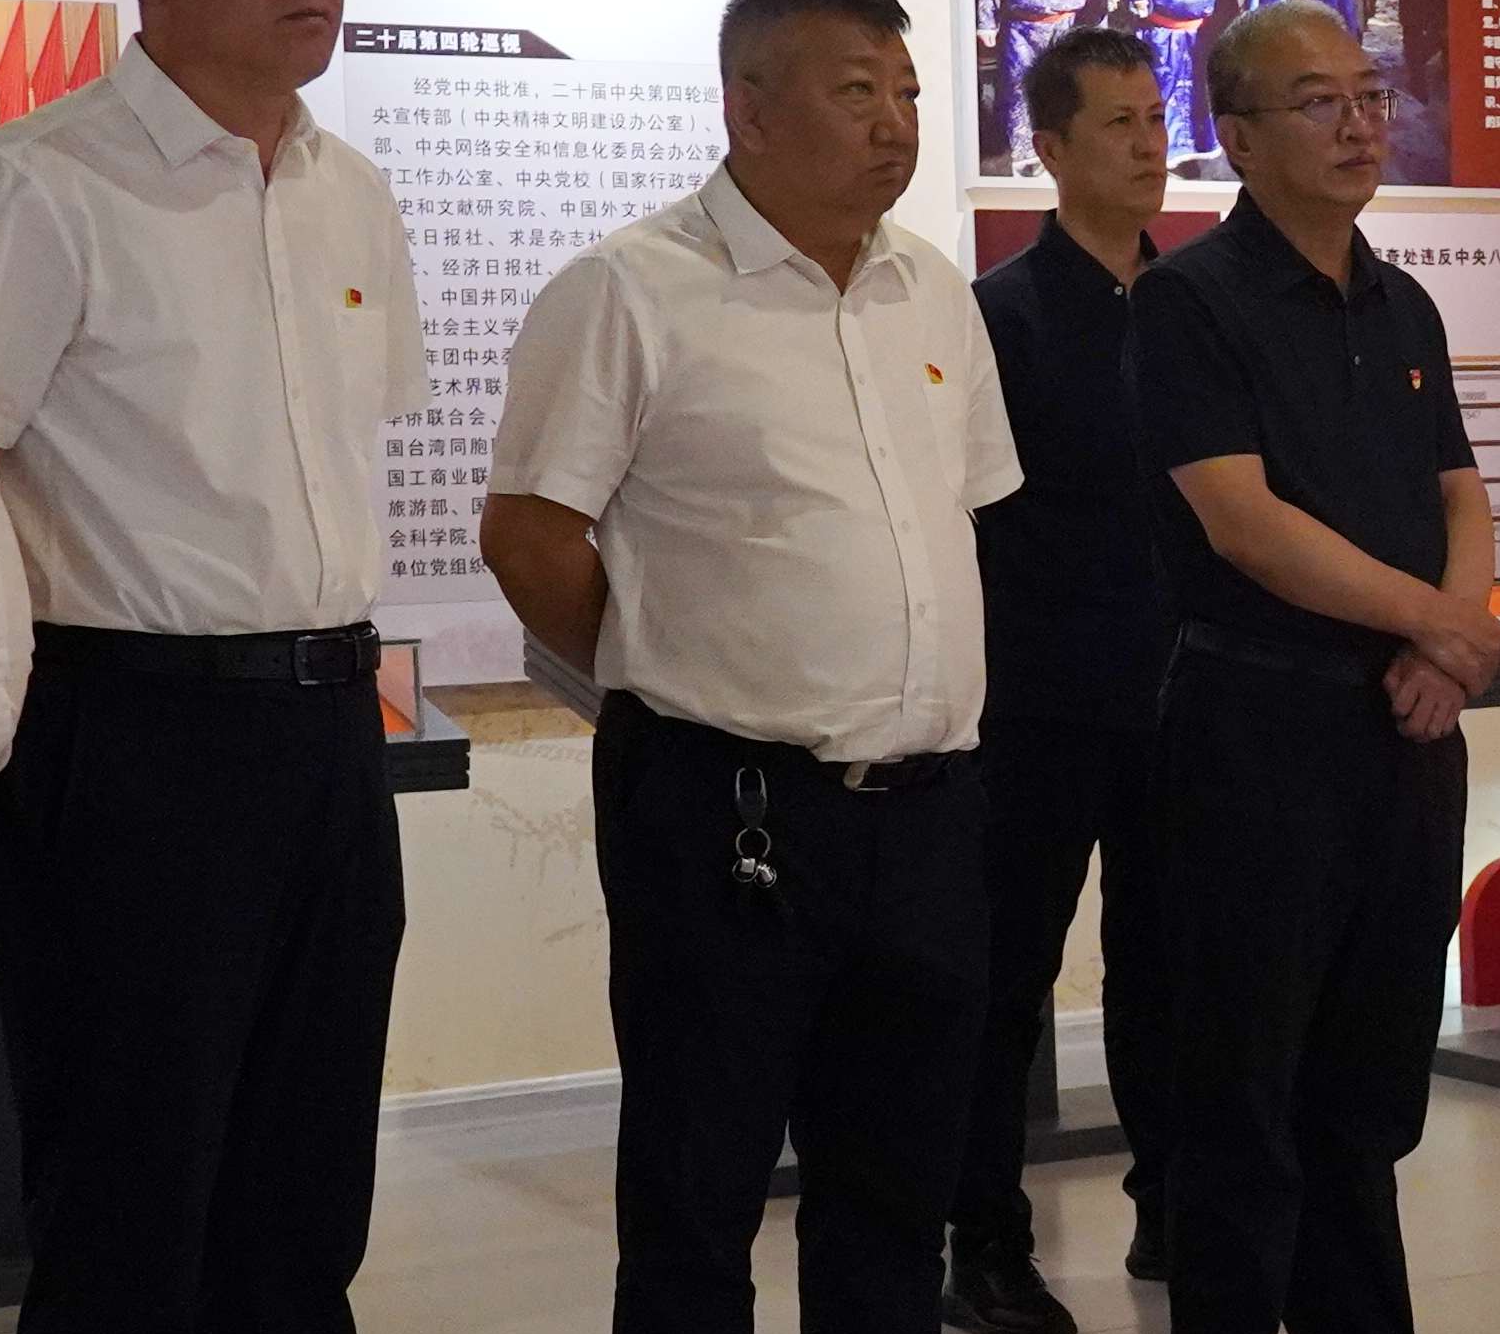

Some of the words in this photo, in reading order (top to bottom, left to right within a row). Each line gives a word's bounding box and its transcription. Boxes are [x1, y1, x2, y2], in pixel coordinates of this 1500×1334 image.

[355, 29, 522, 55] 二十届第四轮巡视
[378, 167, 711, 190] 工作办公室、中央党校（国家行政学
[398, 197, 678, 219] 史和文献研究院、中国外文出
[411, 257, 554, 276] 、经济日报社、
[421, 317, 520, 336] 社会主义学
[386, 437, 495, 457] 国台湾同胞
